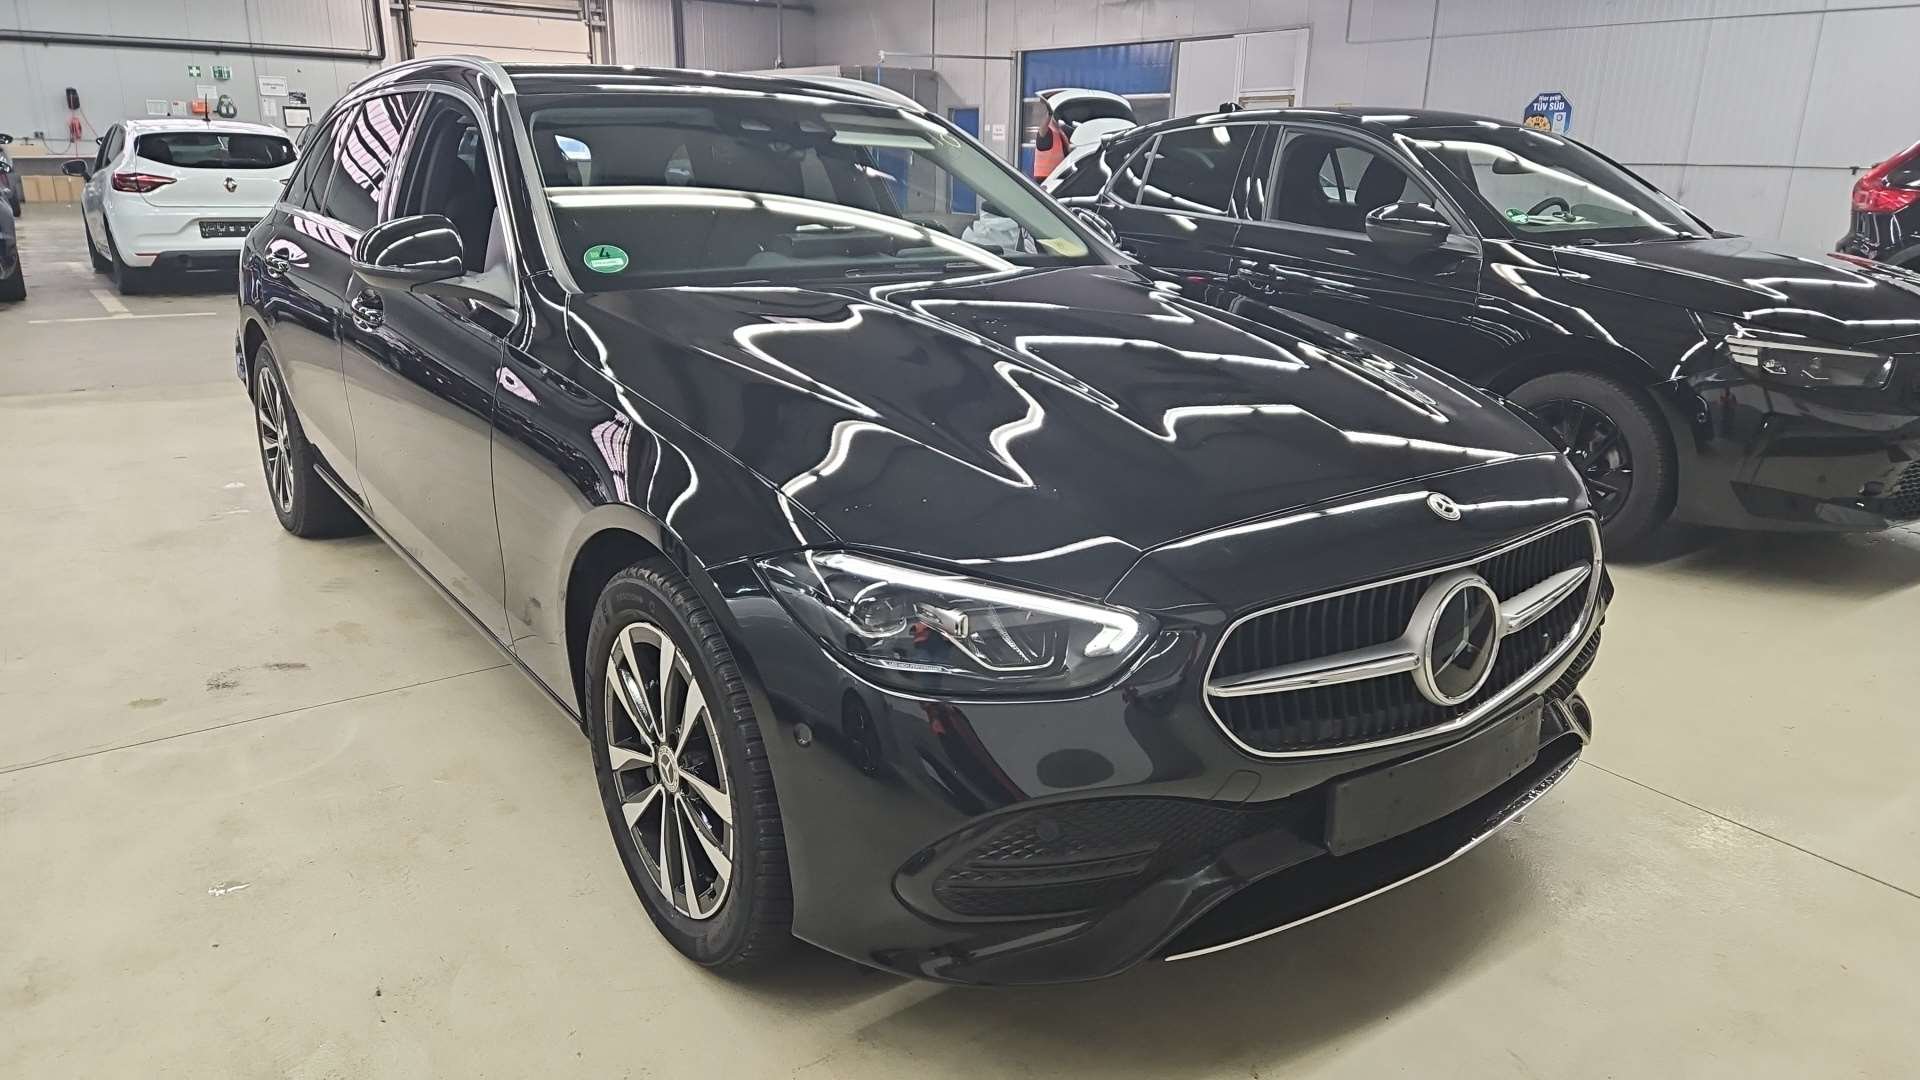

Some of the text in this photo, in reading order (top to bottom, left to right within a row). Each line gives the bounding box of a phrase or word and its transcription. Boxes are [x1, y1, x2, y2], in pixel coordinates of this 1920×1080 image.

[1533, 101, 1564, 111] TÜV SÜD
[599, 247, 611, 258] 4
